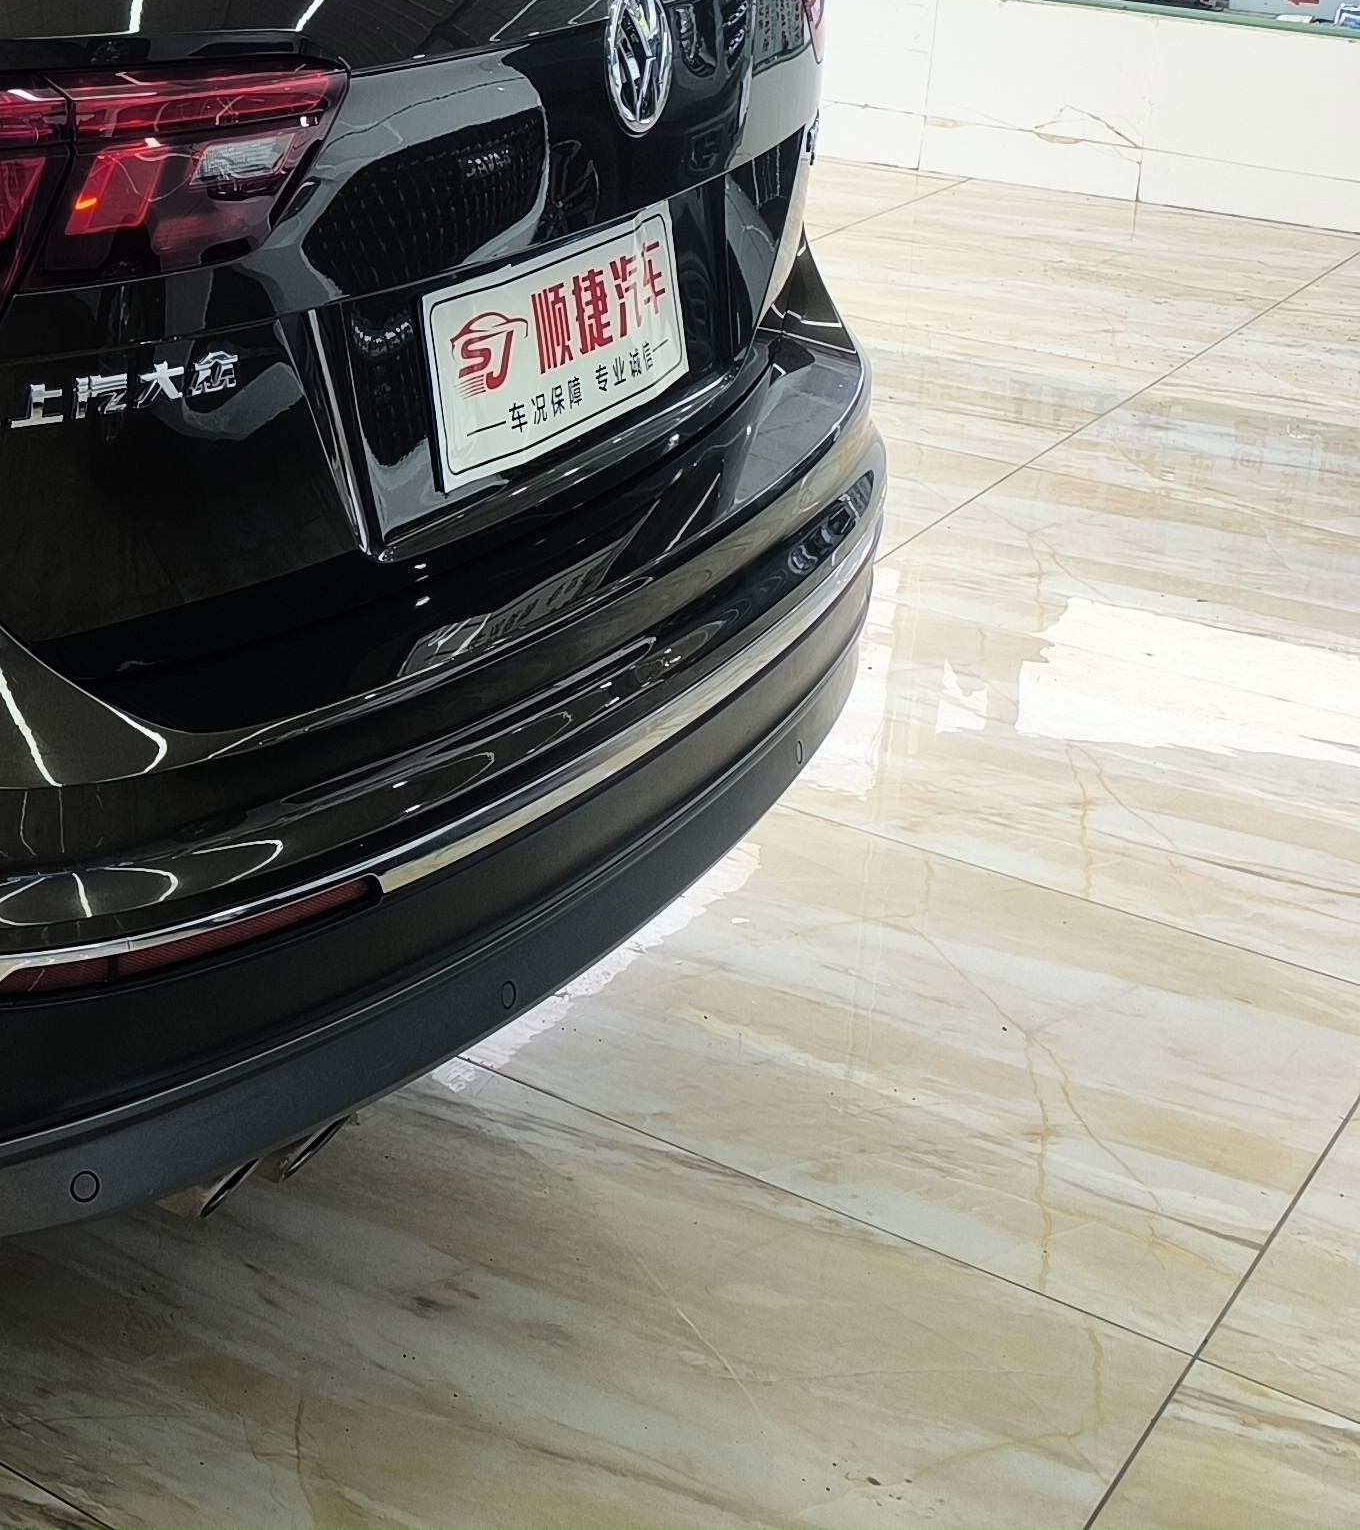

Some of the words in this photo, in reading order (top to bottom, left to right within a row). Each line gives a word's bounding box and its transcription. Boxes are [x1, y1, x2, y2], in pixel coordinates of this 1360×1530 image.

[530, 240, 667, 375] 顺捷汽车
[8, 350, 239, 429] 上汽大众
[508, 375, 584, 433] 车况保障
[594, 341, 655, 393] 专业诚信
